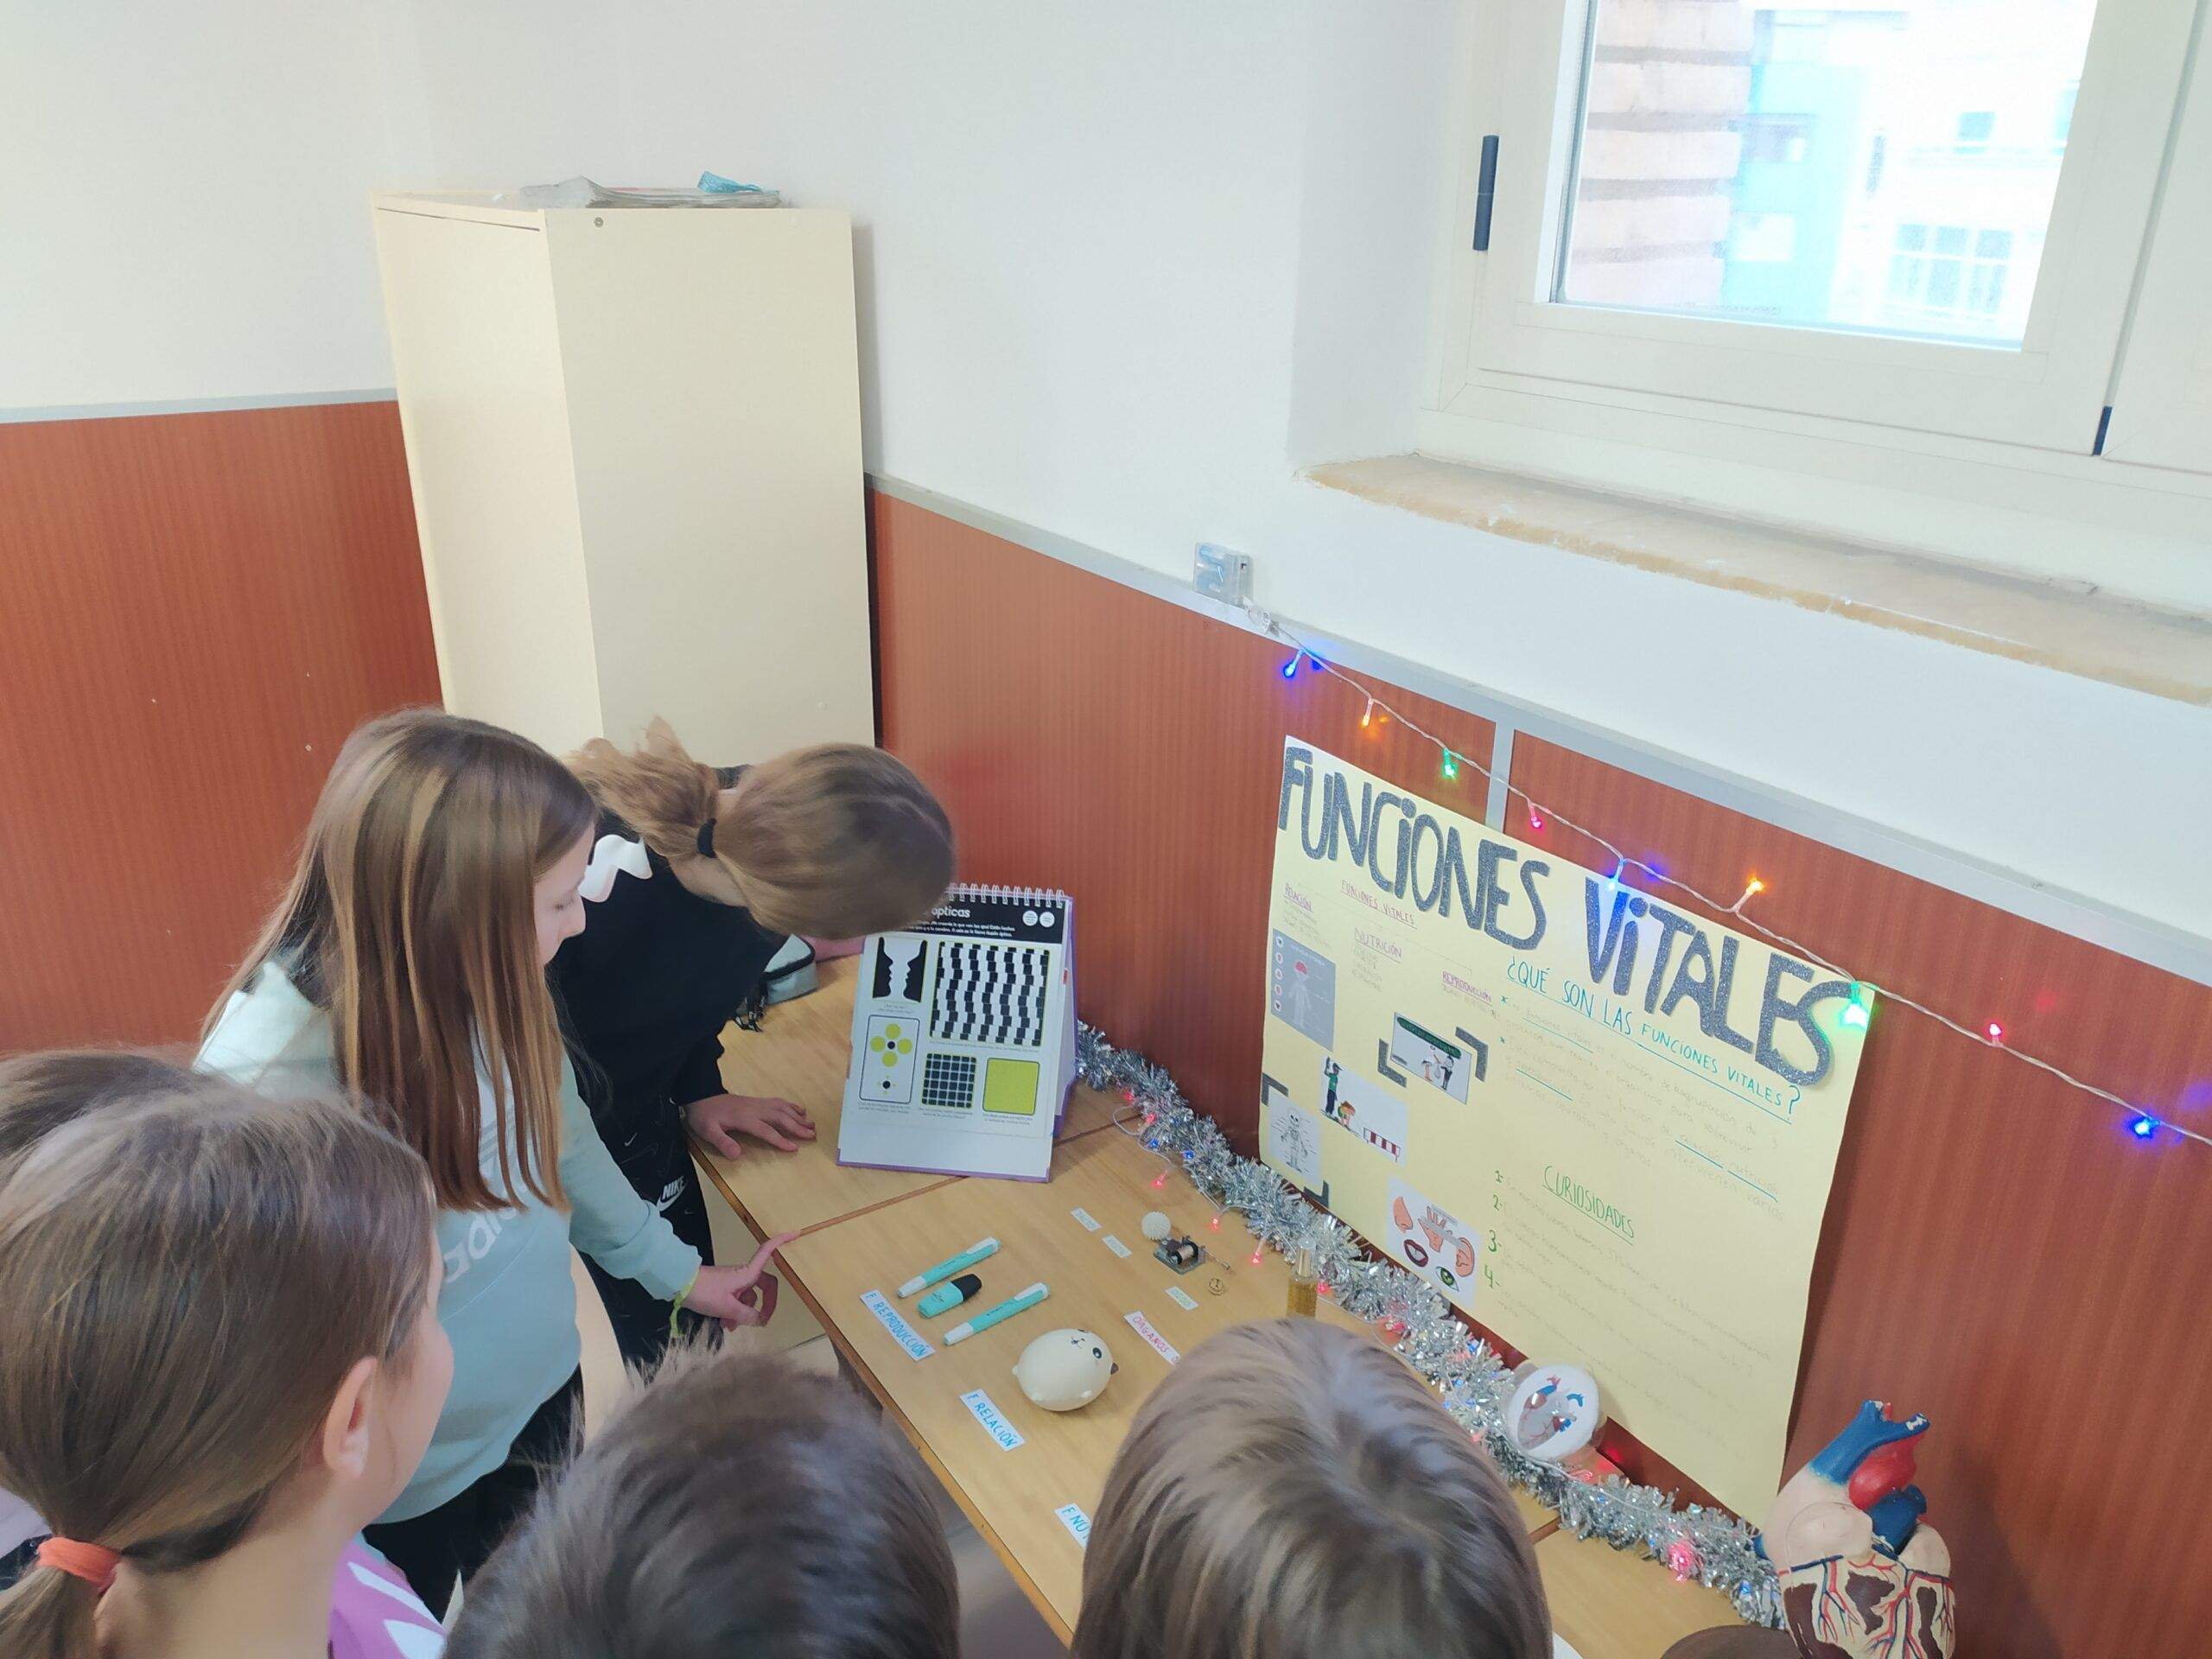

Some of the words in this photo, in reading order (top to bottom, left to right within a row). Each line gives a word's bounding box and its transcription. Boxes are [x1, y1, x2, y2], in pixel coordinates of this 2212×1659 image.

[1507, 956, 1550, 995] ¿QUÉ
[1562, 980, 1596, 1018] SON
[1604, 999, 1633, 1036] LAS
[1640, 1023, 1719, 1074] FUNCIONES
[662, 1175, 684, 1200] NIKE
[1542, 1165, 1636, 1239] CURIOSIDADES
[865, 1292, 878, 1300] F
[873, 1301, 931, 1357] REPRODUCCIÓN
[967, 1393, 980, 1402] F
[974, 1402, 1018, 1448] RELACIÓN
